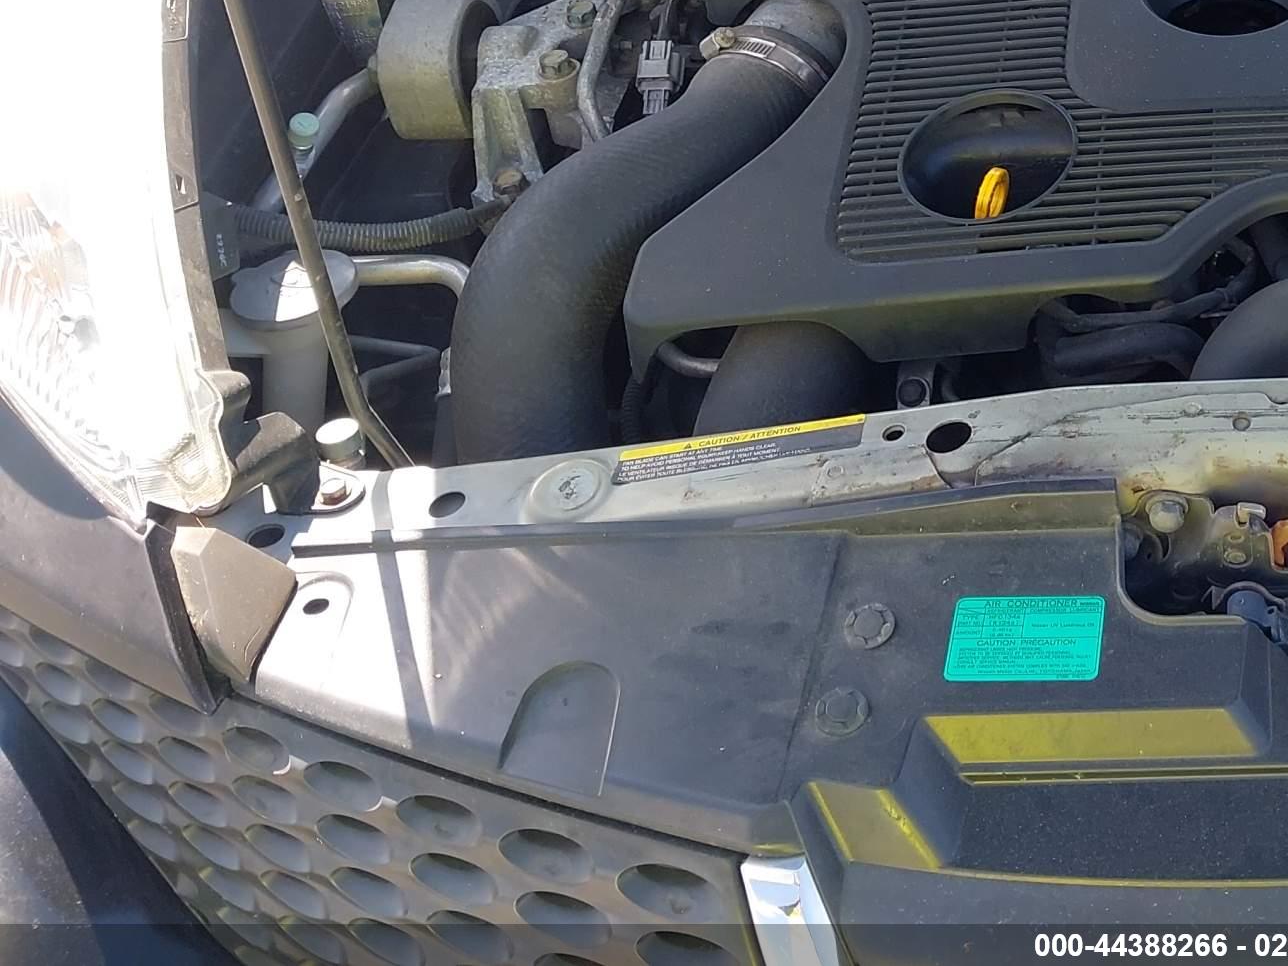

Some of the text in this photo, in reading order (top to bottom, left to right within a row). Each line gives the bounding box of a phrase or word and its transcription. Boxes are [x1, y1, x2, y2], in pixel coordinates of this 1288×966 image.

[698, 435, 740, 447] CAUTION
[750, 425, 801, 439] ATTENTION
[985, 600, 1001, 608] AIR
[1007, 599, 1078, 608] CONDITIONER
[976, 638, 1016, 647] CAUTION
